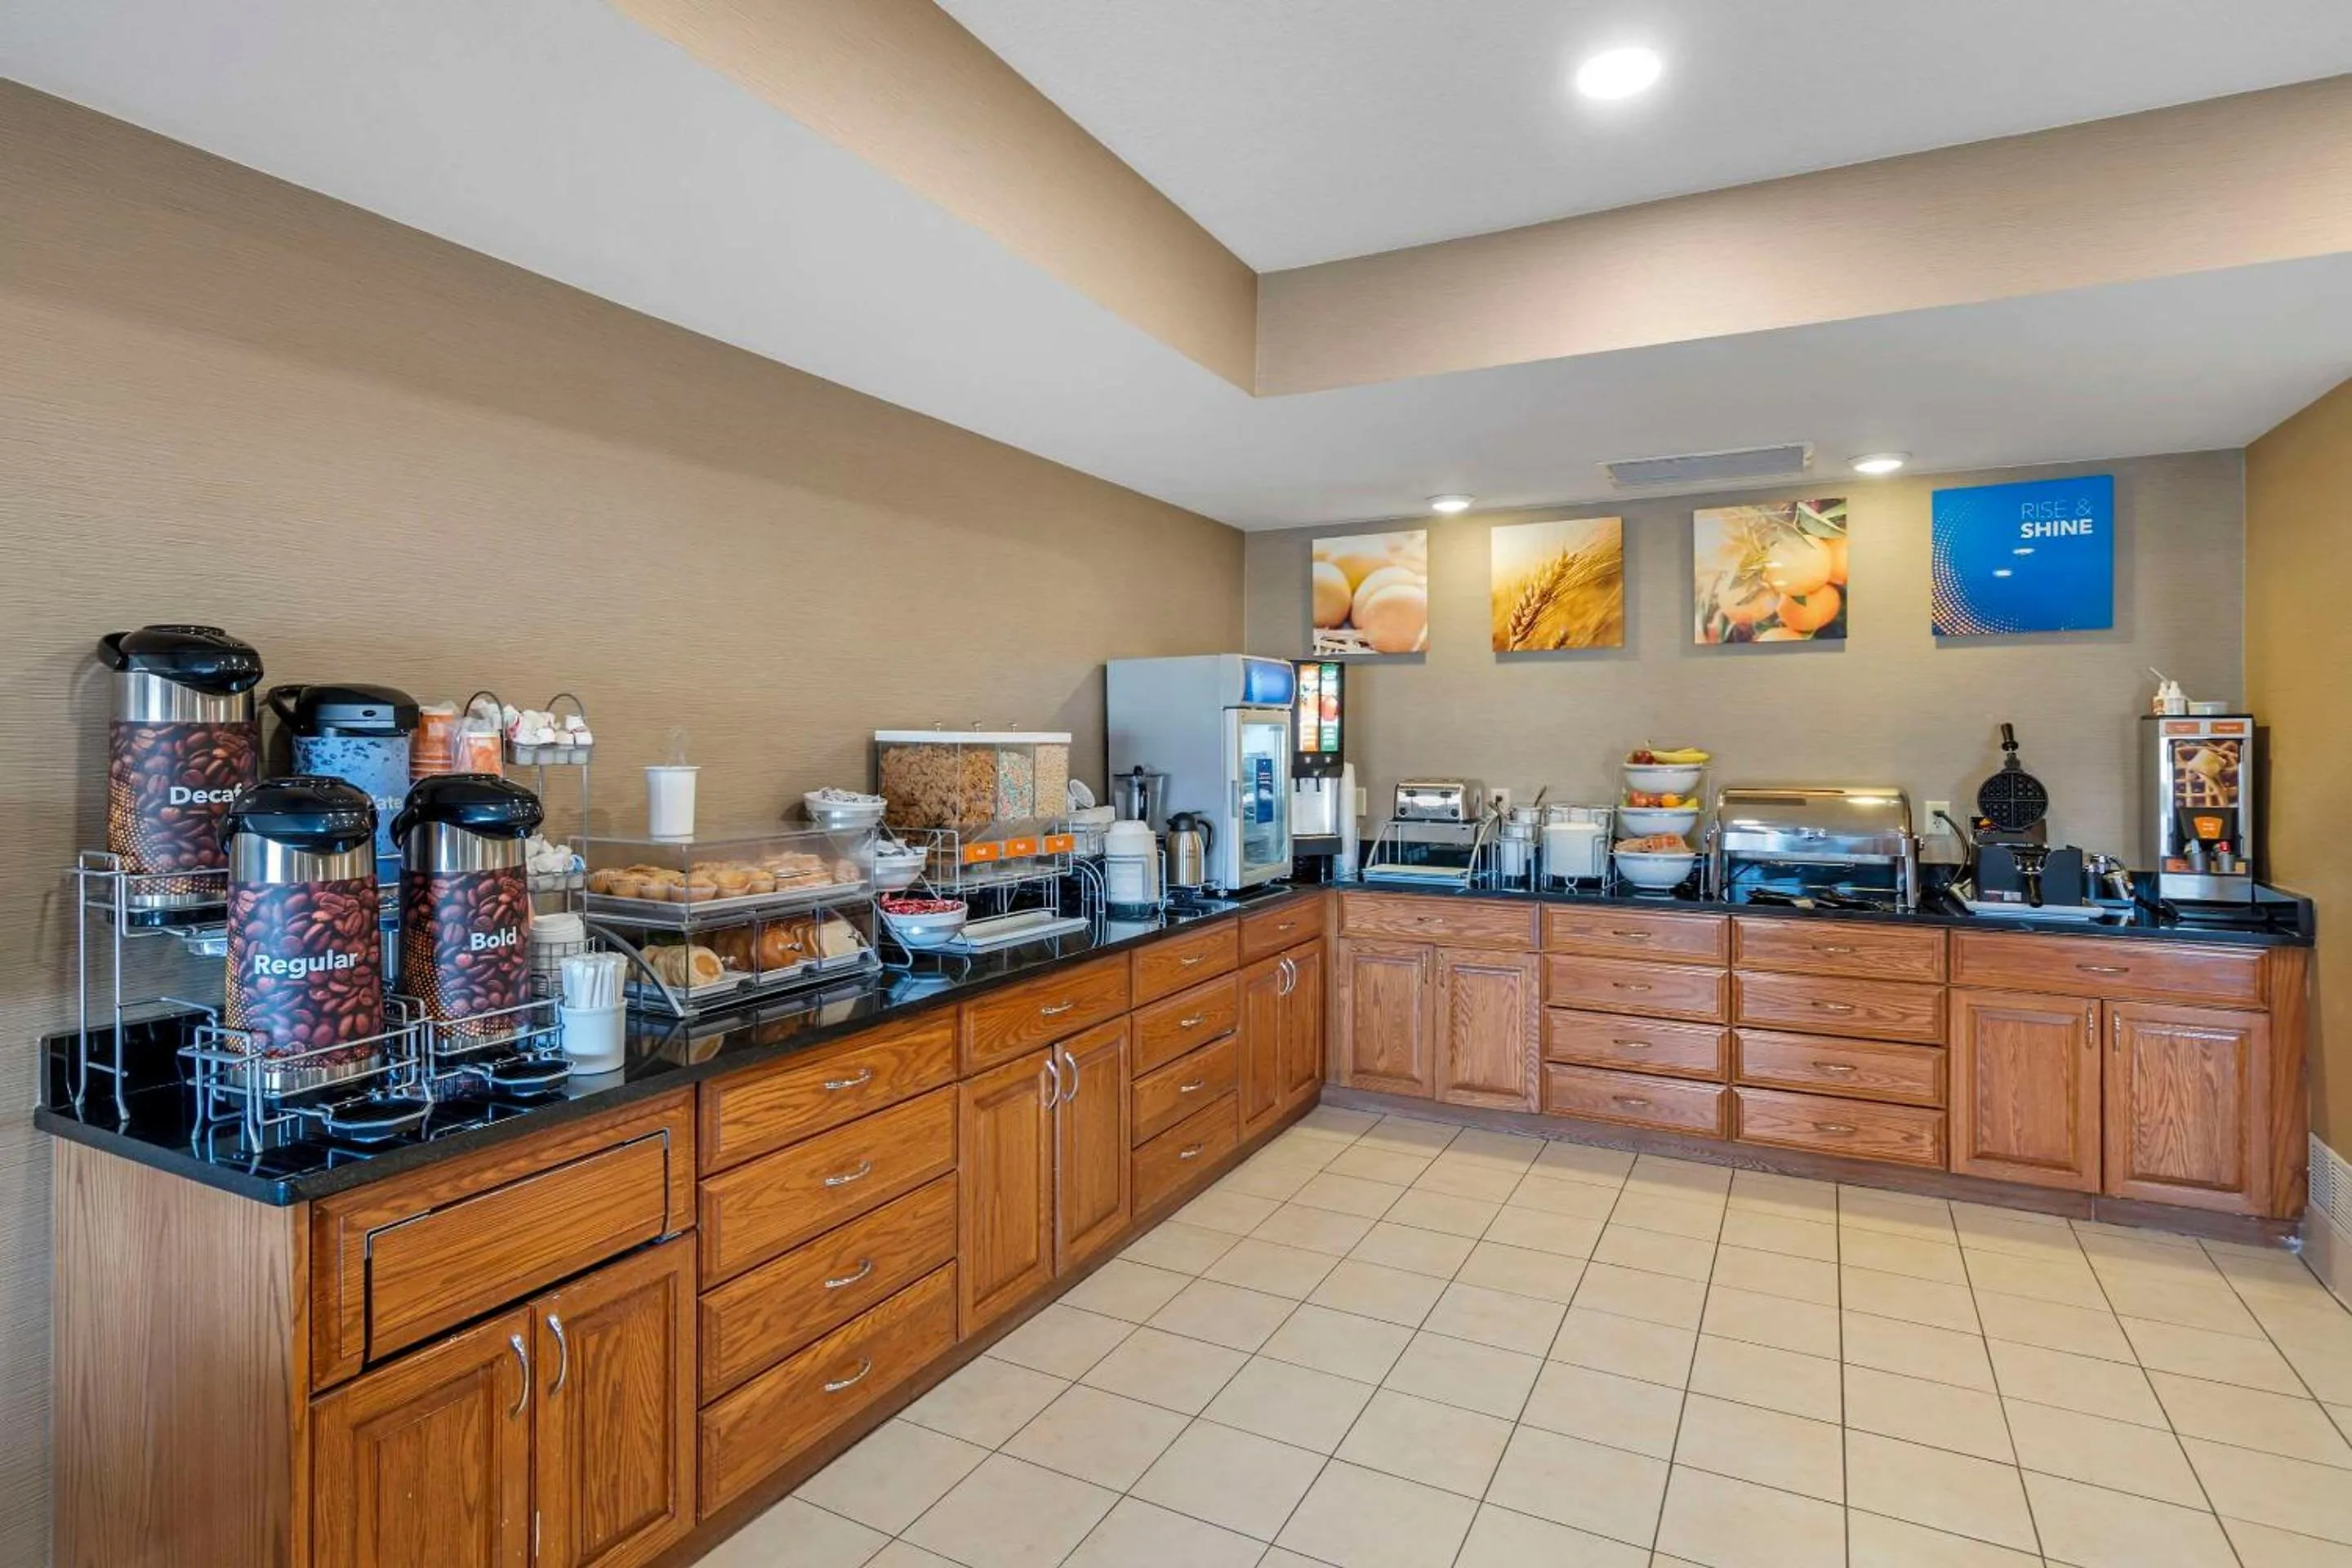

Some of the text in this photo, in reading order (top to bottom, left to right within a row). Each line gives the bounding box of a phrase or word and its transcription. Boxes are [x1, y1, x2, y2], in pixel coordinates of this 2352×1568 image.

[2021, 497, 2092, 519] RISE &
[2020, 519, 2093, 539] SHINE
[470, 927, 517, 951] Bold
[254, 949, 359, 979] Regular
